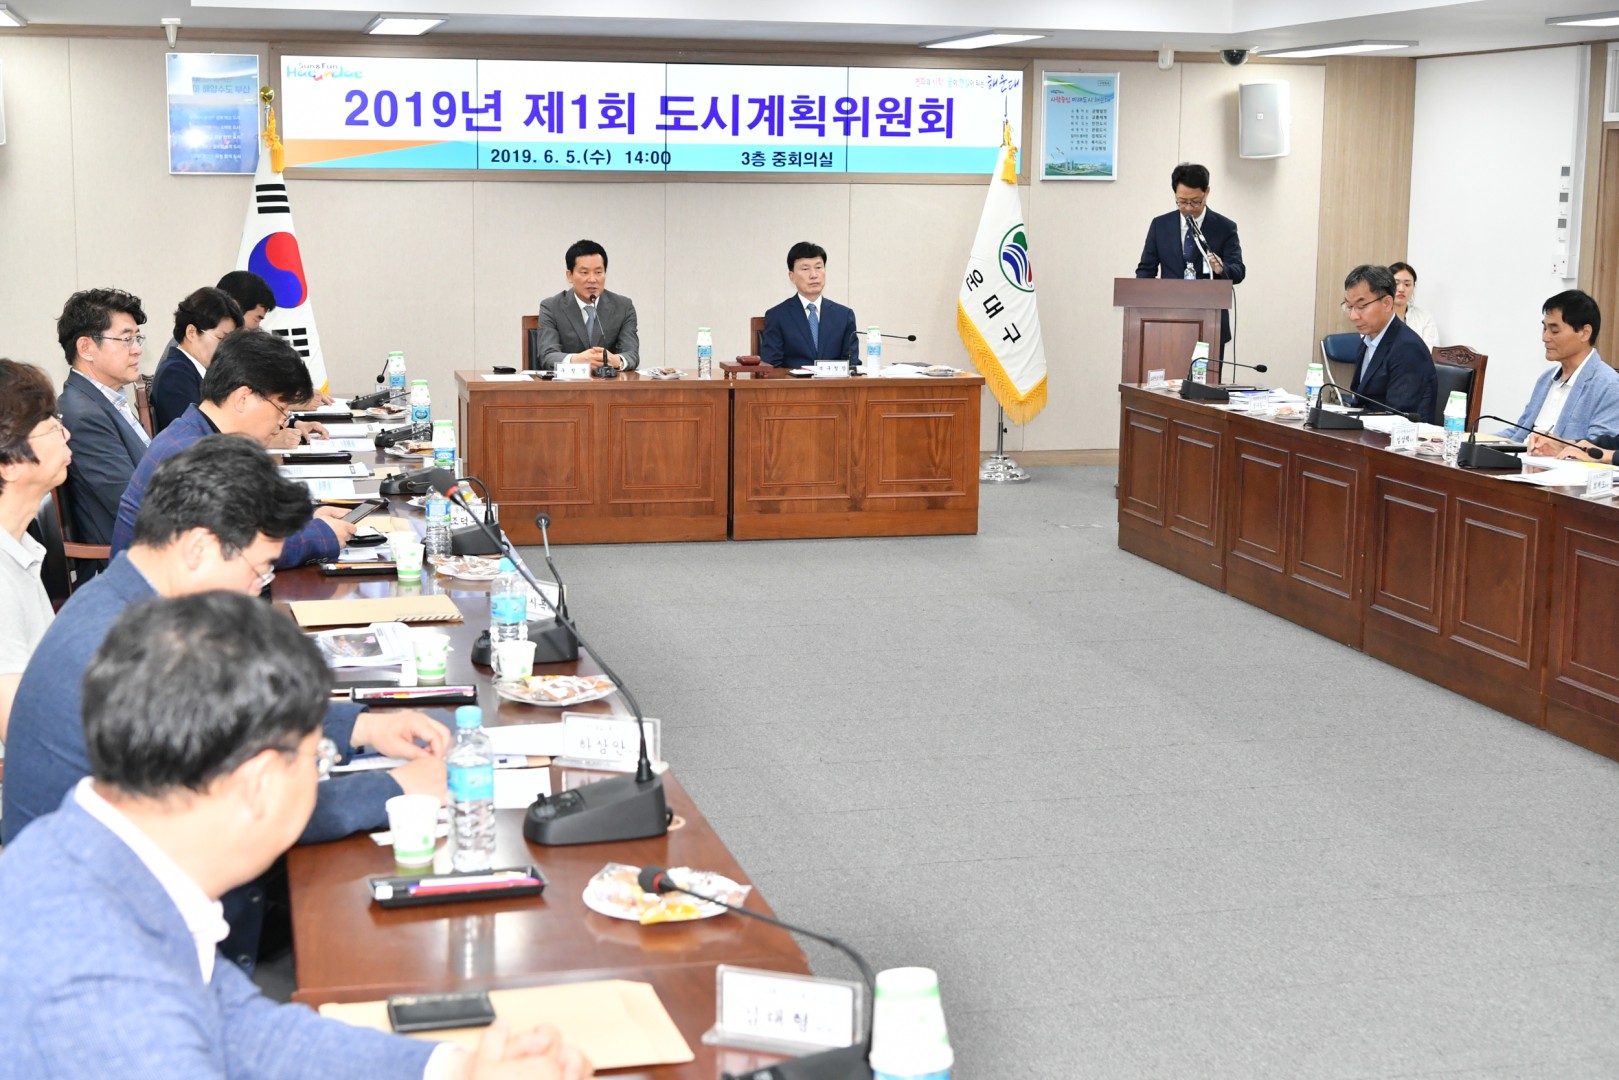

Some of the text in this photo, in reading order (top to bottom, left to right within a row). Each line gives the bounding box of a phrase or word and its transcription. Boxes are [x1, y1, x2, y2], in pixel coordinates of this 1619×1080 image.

[986, 74, 1020, 93] 해운대
[345, 89, 954, 139] 2019년 제1회 도시계획위원회
[490, 149, 833, 167] 2019. 6. 5.(수) 14:00 3층 중회의실
